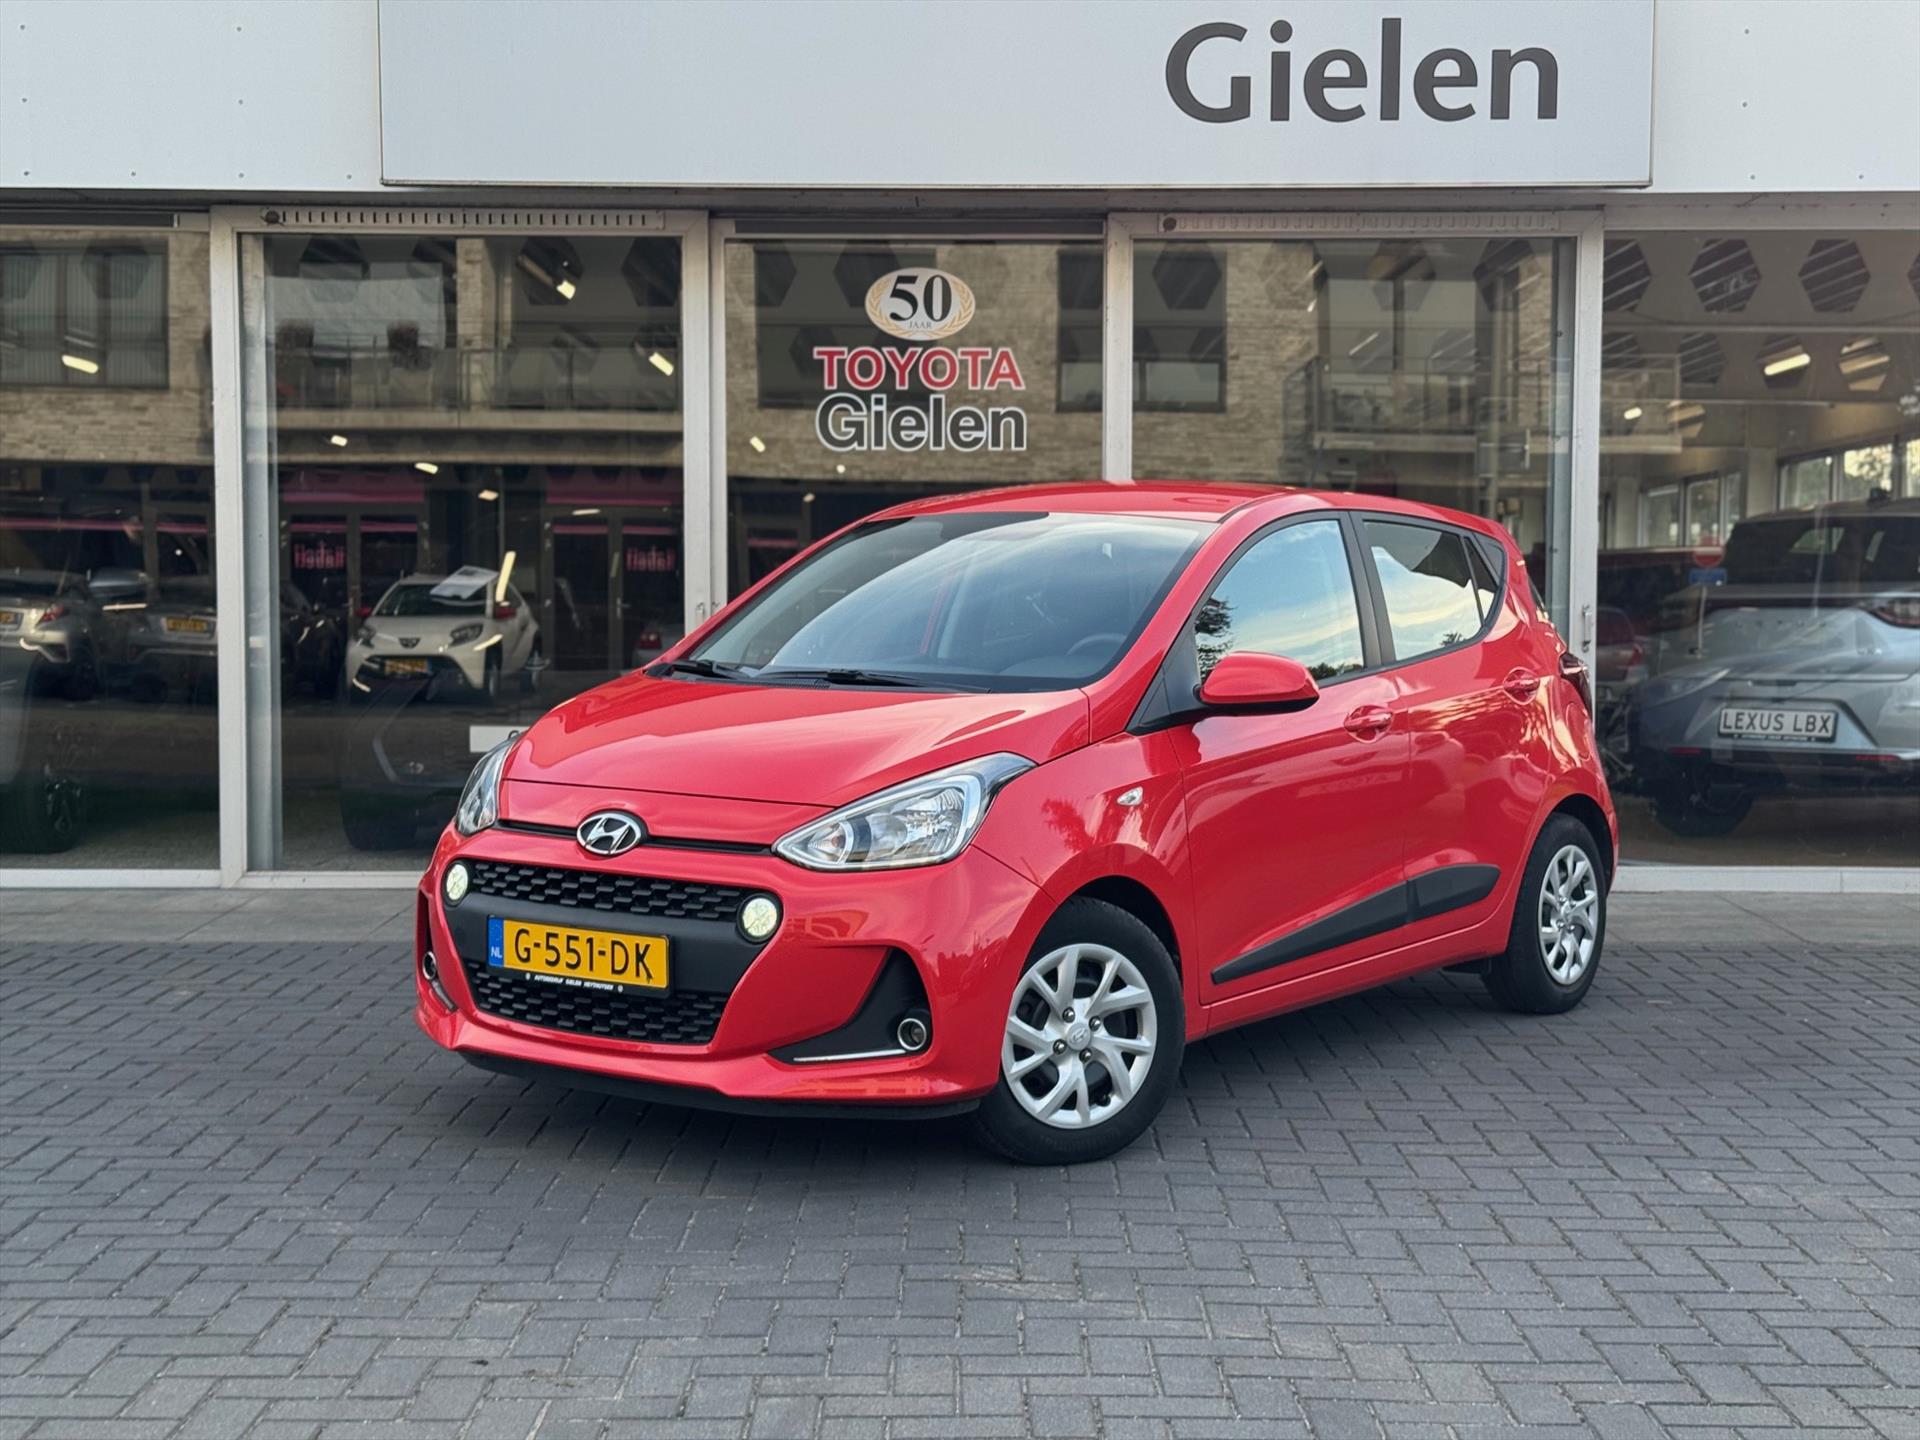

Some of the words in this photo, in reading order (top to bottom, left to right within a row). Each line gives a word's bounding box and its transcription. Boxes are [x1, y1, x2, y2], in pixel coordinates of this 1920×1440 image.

[1165, 17, 1558, 123] Gielen
[889, 274, 952, 322] 50
[909, 320, 932, 329] JAAR
[814, 347, 1025, 390] TOYOTA
[816, 392, 1027, 452] Gielen
[1722, 711, 1785, 731] LEXUS
[1793, 714, 1831, 733] LBX
[490, 945, 503, 959] NL
[514, 928, 653, 980] G-551-DK
